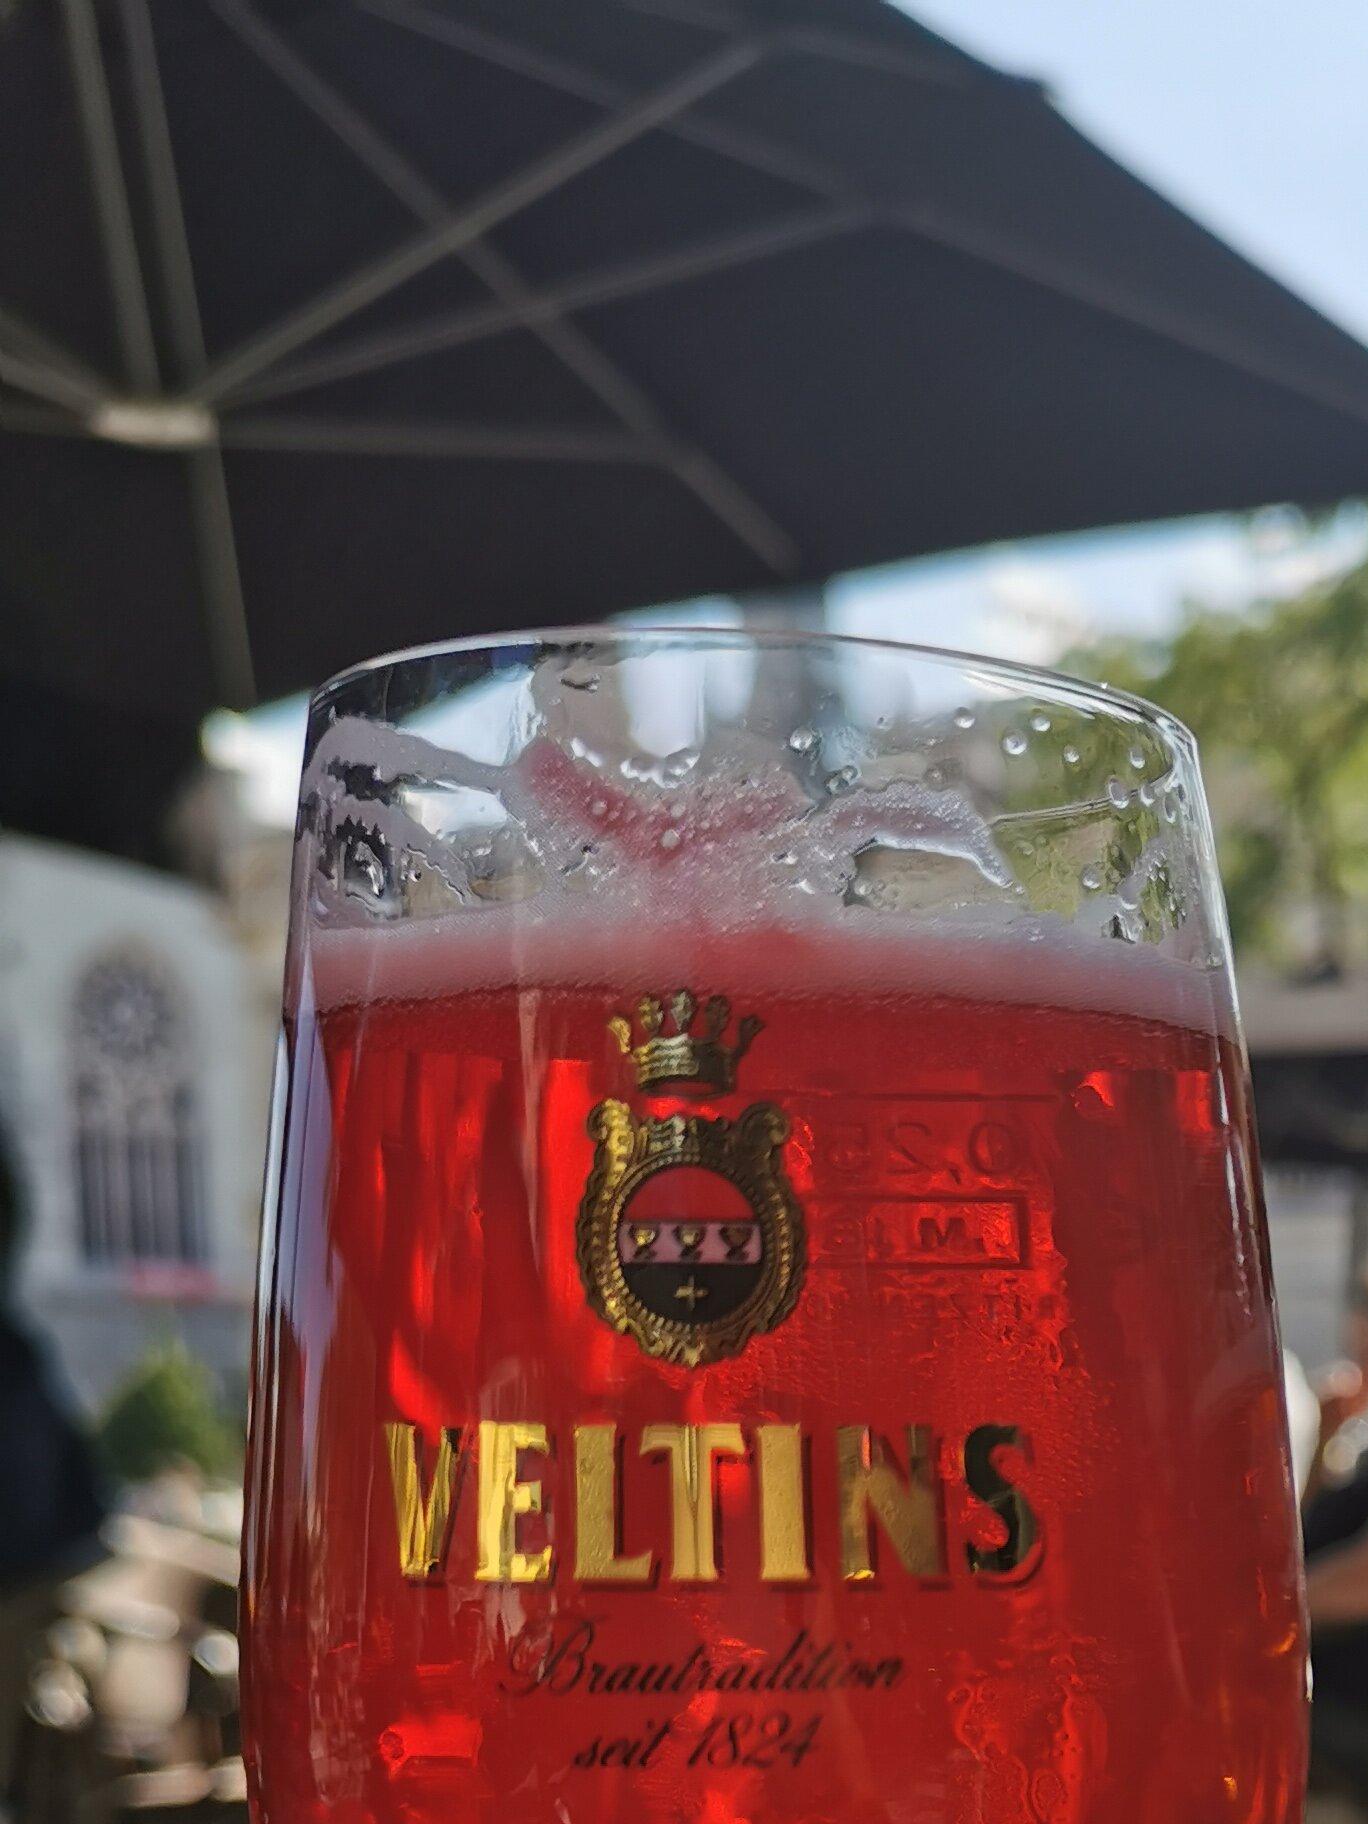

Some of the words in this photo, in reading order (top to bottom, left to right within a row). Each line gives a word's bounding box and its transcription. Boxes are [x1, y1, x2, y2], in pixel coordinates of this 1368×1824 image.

[384, 1420, 1042, 1587] VELTINS
[500, 1620, 902, 1697] Brautradition
[573, 1719, 670, 1768] seit
[688, 1710, 823, 1769] 1824
